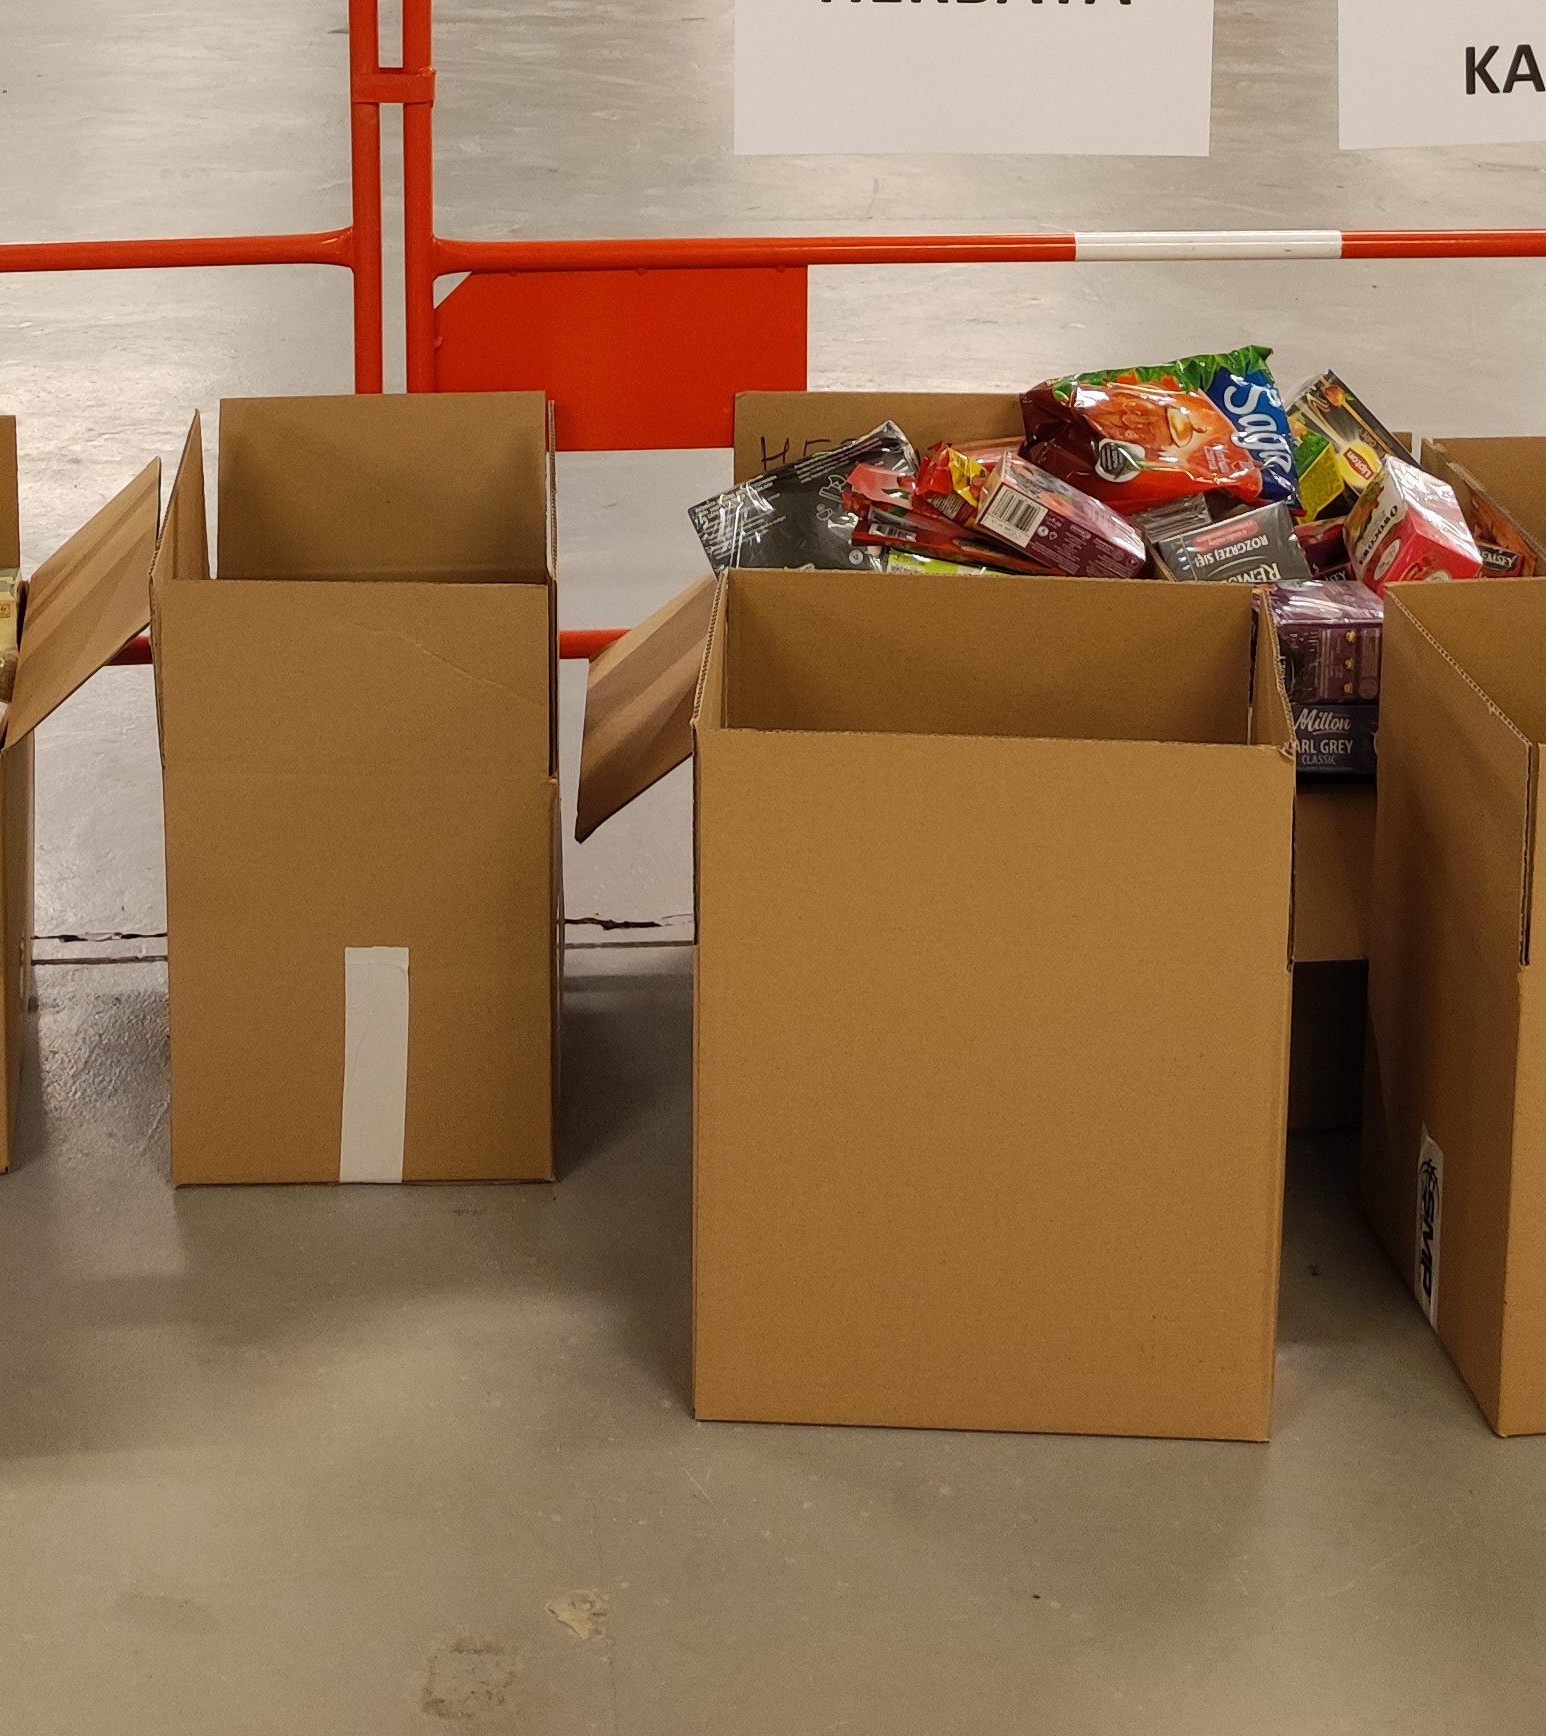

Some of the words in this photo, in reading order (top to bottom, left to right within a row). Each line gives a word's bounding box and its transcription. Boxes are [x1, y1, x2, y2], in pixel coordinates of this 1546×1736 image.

[1345, 449, 1375, 480] Lipton
[1215, 534, 1269, 561] ROZGRZEJ
[1295, 738, 1318, 754] ARL
[1320, 738, 1354, 755] GREY
[1301, 754, 1337, 765] CLASSIC
